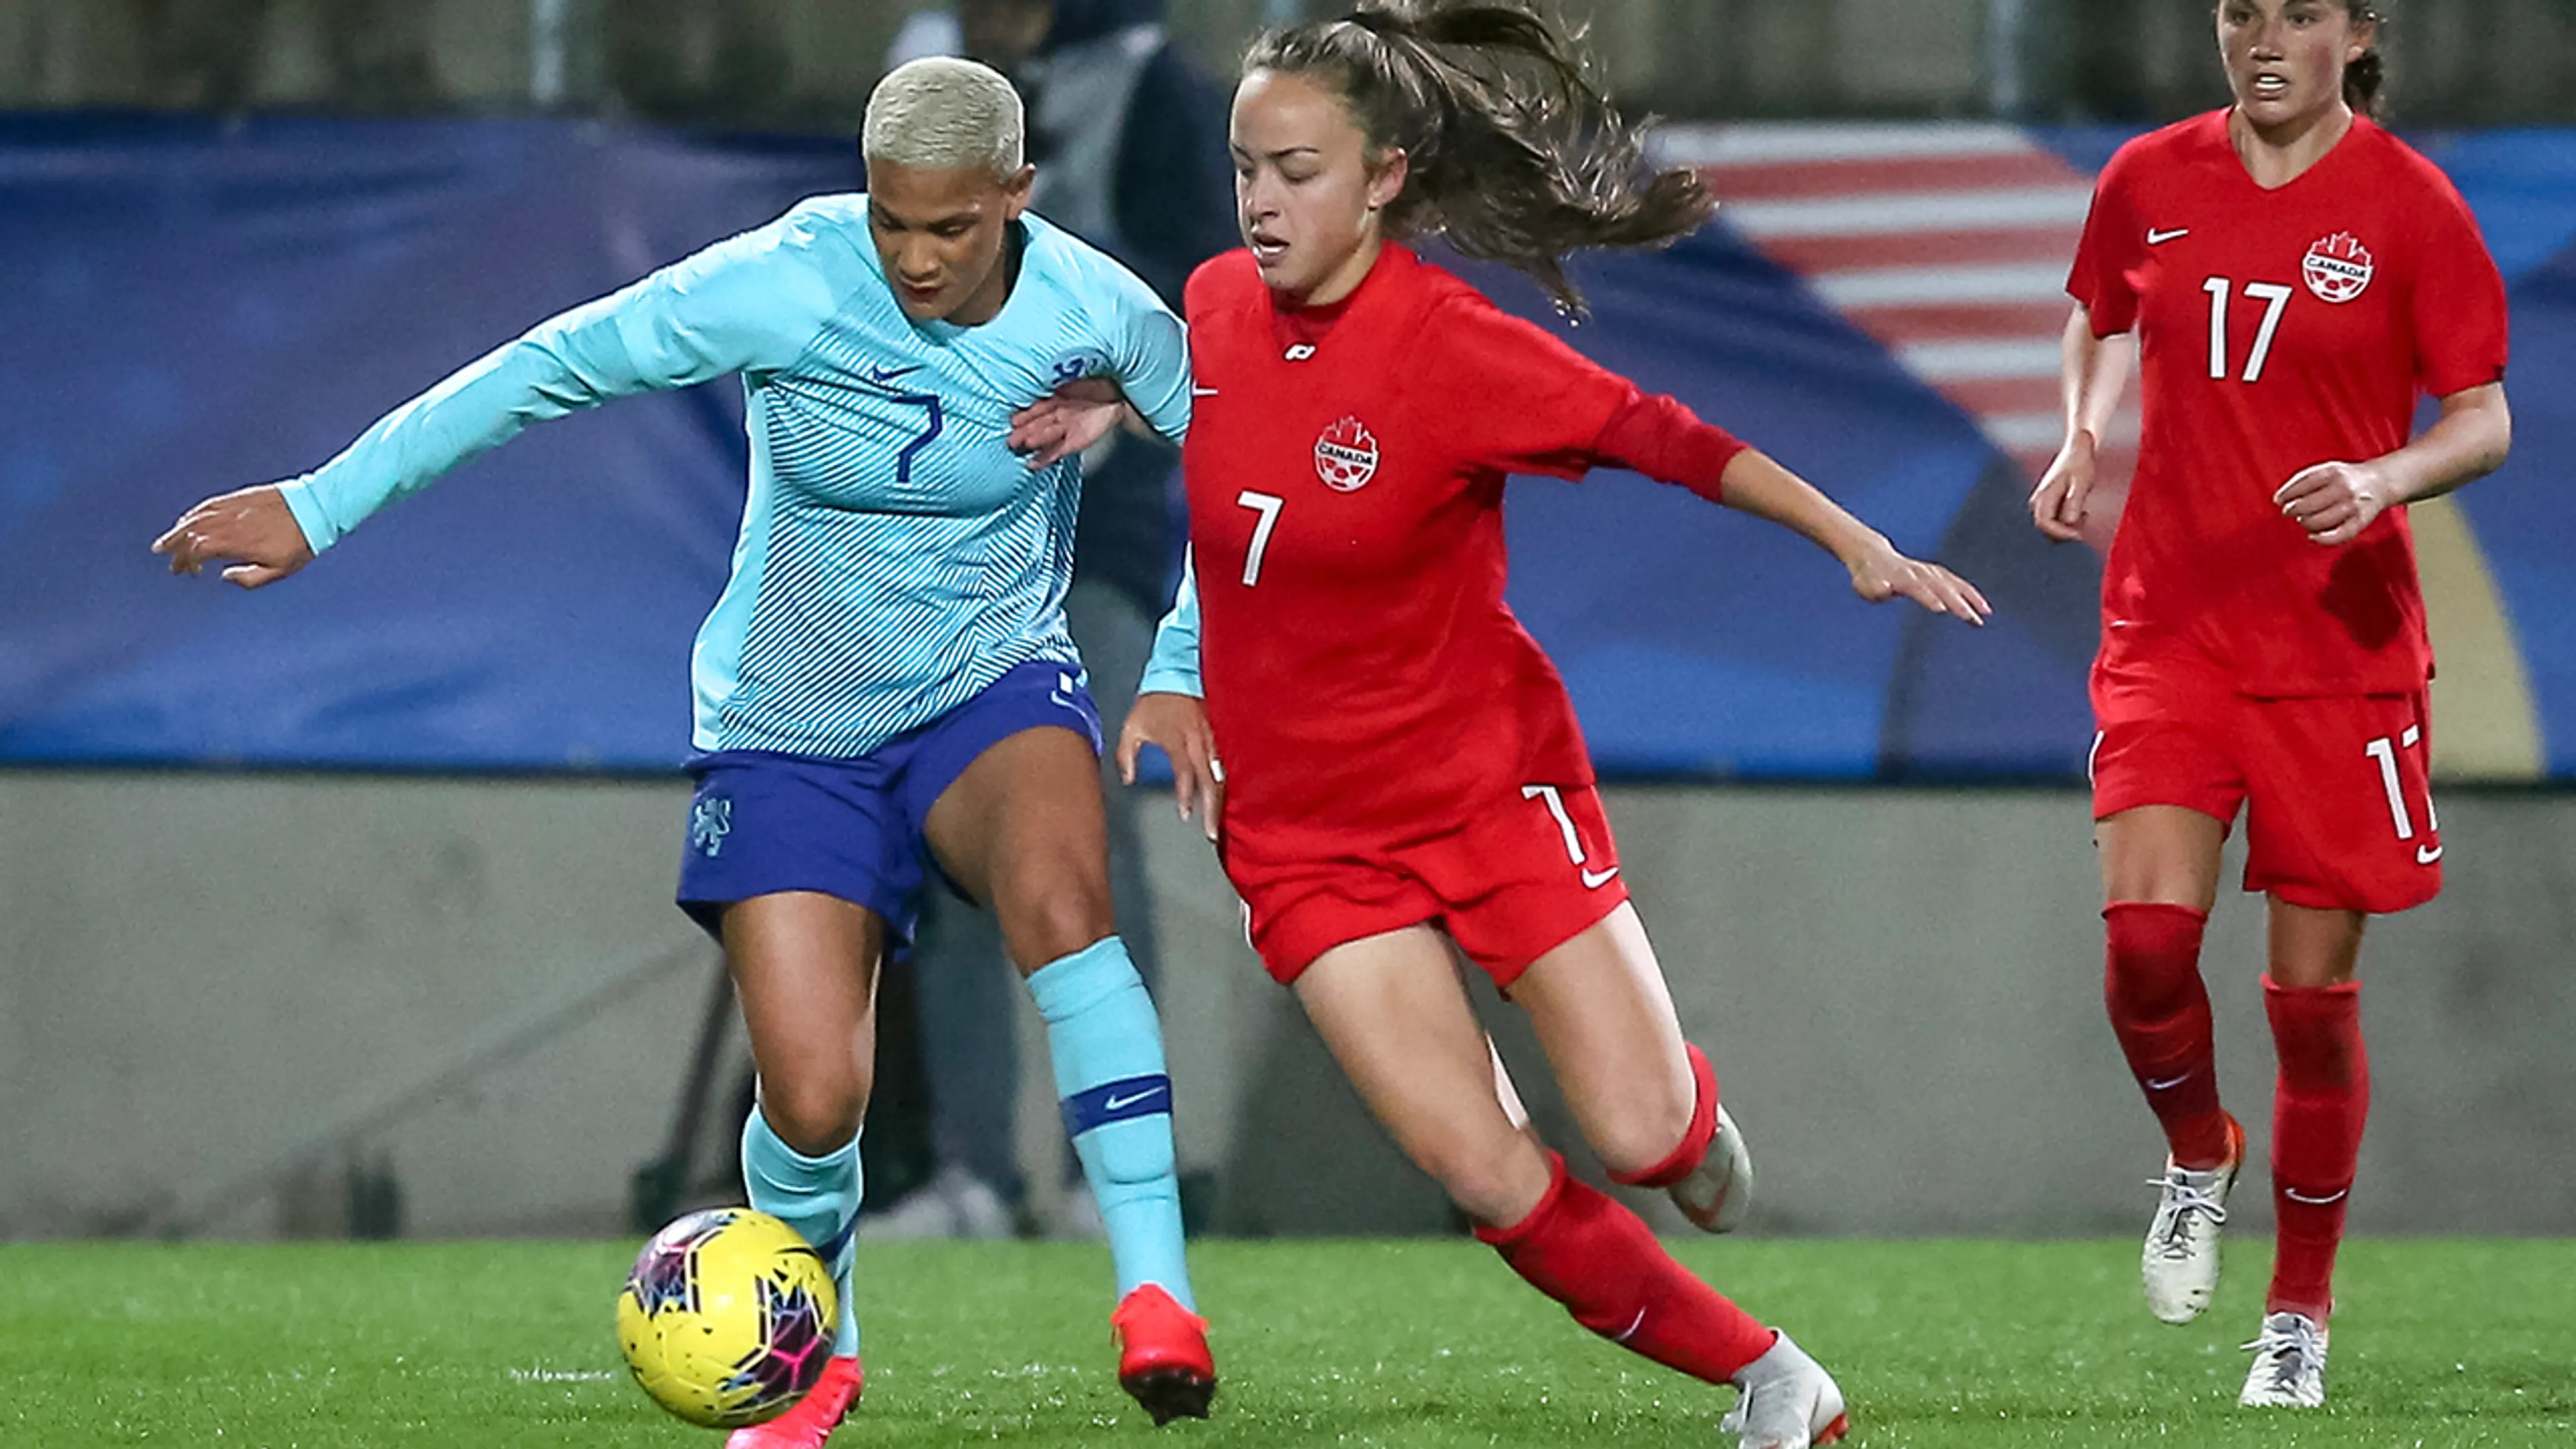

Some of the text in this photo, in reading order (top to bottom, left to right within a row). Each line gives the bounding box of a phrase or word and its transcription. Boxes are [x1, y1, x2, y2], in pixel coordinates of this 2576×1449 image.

[2306, 257, 2365, 278] CANADA
[2203, 276, 2293, 381] 17
[891, 394, 943, 483] 7
[1318, 443, 1373, 465] CANADA
[1237, 490, 1283, 587] 7
